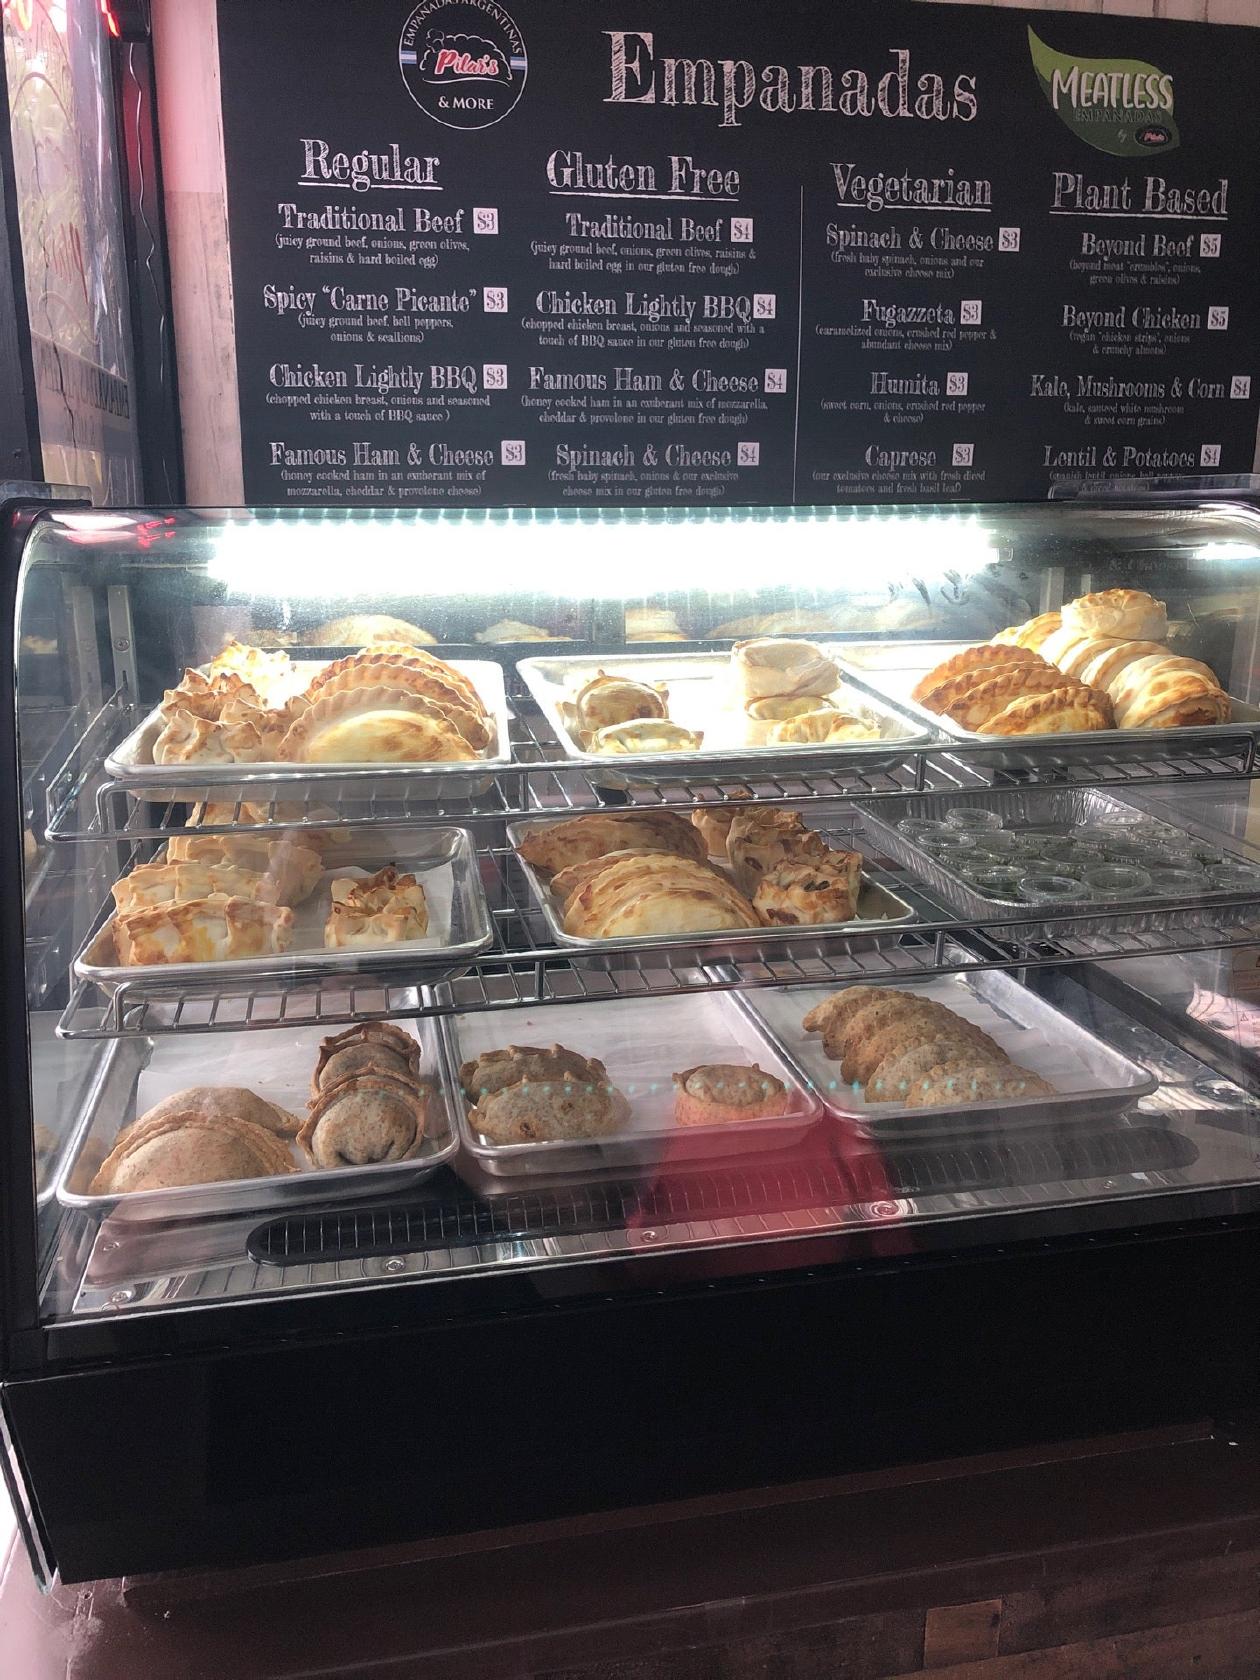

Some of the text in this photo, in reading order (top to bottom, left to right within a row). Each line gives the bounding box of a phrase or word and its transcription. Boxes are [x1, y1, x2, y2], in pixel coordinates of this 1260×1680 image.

[601, 31, 978, 127] Empanadas
[1052, 65, 1174, 110] MEATLESS
[438, 96, 495, 110] & MORE
[1074, 108, 1162, 123] EMPANADAS
[299, 138, 440, 191] Regular
[546, 149, 741, 195] Gluten Free
[830, 163, 992, 211] Vegetarian
[1050, 172, 1228, 214] Plant Based
[277, 203, 464, 233] Traditional Beef
[476, 211, 495, 230] $3
[564, 212, 723, 241] Traditional Beef
[733, 221, 749, 240] $4
[825, 223, 993, 251] Spinach & Cheese
[1001, 230, 1018, 249] $3
[274, 233, 303, 249] (juicy
[305, 235, 341, 248] ground
[408, 240, 437, 251] green
[558, 242, 593, 256] ground
[655, 247, 682, 258] green
[715, 247, 746, 258] raisins
[748, 247, 756, 259] &
[1081, 232, 1194, 261] Beyond Beef
[309, 252, 438, 269] raisins & hard boiled egg)
[548, 257, 571, 270] hard
[573, 258, 603, 270] boiled
[605, 261, 622, 273] egg
[625, 260, 634, 271] in
[637, 262, 654, 271] our
[655, 261, 685, 274] gluten
[687, 261, 706, 273] free
[262, 284, 476, 316] Spicy “Carne Picante”
[485, 291, 504, 309] $3
[535, 290, 751, 322] Chicken Lightly BBQ
[756, 297, 773, 315] $4
[297, 313, 325, 328] (juicy
[328, 314, 363, 328] ground
[392, 315, 410, 326] bell
[861, 299, 955, 328] Fugazzeta
[962, 303, 978, 321] $3
[1062, 305, 1200, 334] Beyond Chicken
[330, 330, 424, 343] onions & scallions)
[538, 334, 565, 346] touch
[567, 333, 578, 346] of
[580, 334, 605, 348] BBQ
[606, 338, 633, 347] sauce
[636, 335, 646, 347] in
[648, 338, 664, 347] our
[666, 336, 696, 349] gluten
[698, 336, 716, 348] free
[268, 363, 477, 394] Chicken Lightly BBQ
[485, 367, 504, 386] $3
[529, 366, 758, 392] Famous Ham & Cheese
[766, 372, 782, 390] $4
[870, 371, 940, 395] Humita
[948, 374, 965, 392] $3
[1029, 374, 1225, 398] Kale, Mushrooms & Corn
[265, 393, 311, 407] (chopped
[313, 394, 352, 404] chicken
[390, 394, 423, 405] onions
[425, 394, 445, 405] and
[446, 395, 490, 406] seasoned
[309, 409, 331, 420] with
[334, 412, 341, 420] a
[344, 409, 371, 421] touch
[374, 409, 385, 421] of
[387, 409, 413, 423] BBQ
[415, 412, 443, 421] sauce
[269, 441, 494, 465] Famous Ham & Cheese
[505, 443, 522, 461] $3
[555, 443, 731, 472] Spinach & Cheese
[739, 445, 755, 462] $4
[864, 445, 936, 472] Caprese
[954, 446, 970, 464] $3
[1043, 445, 1195, 467] Lentil & Potatoes
[280, 469, 486, 483] (honey cooked ham in an exuberant mix of
[345, 485, 384, 496] cheddar
[387, 485, 395, 496] &
[397, 486, 444, 498] provolone
[446, 485, 481, 496] cheese)
